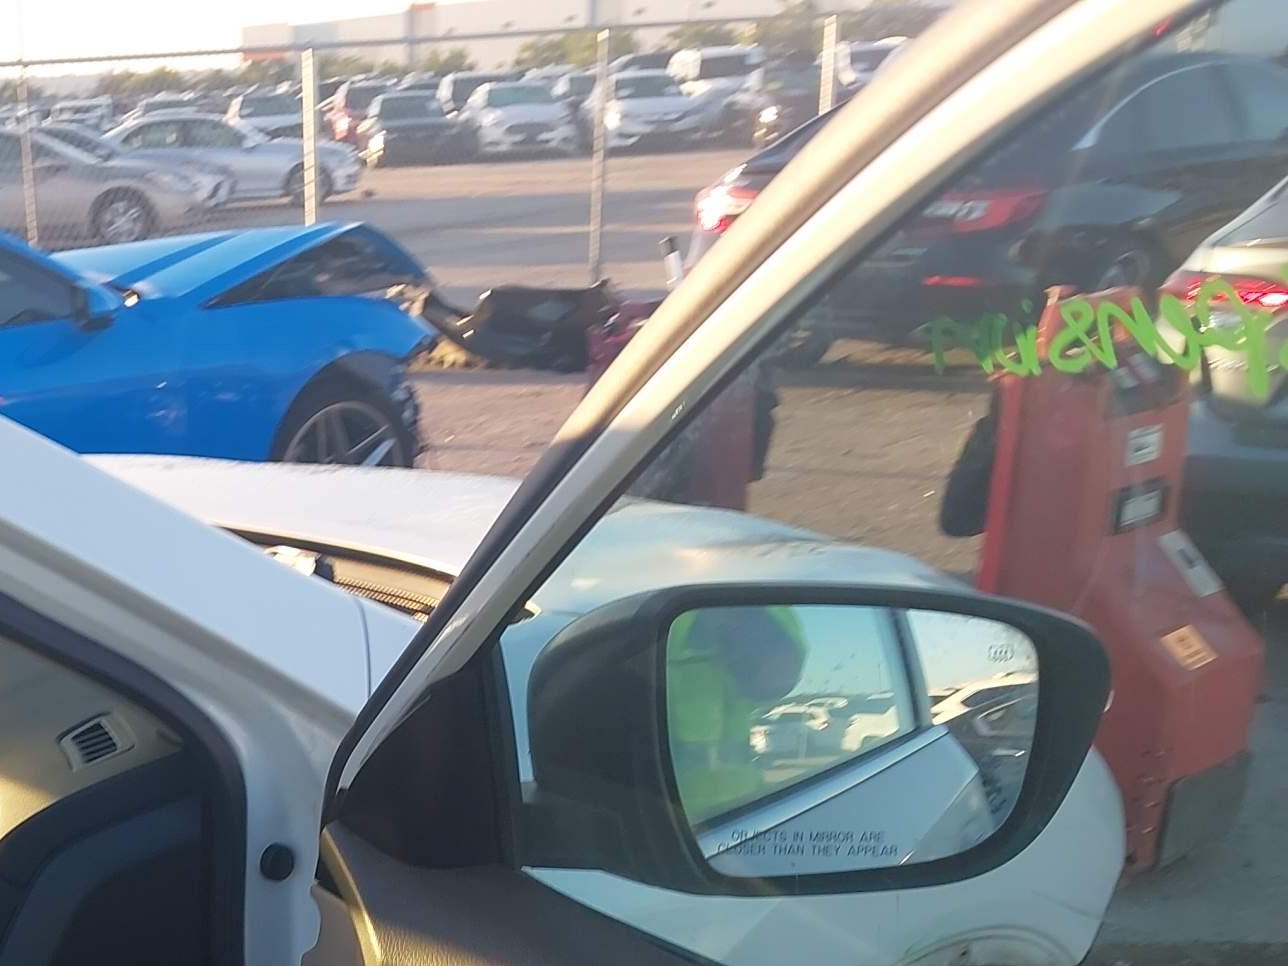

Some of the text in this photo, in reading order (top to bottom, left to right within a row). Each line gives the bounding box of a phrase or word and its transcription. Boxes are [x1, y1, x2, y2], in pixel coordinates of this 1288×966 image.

[792, 830, 805, 841] IN
[809, 830, 854, 841] MIRROR
[859, 830, 884, 841] ARE
[773, 844, 805, 856] THAN
[812, 844, 840, 856] THEY
[847, 844, 898, 856] APPEAR
